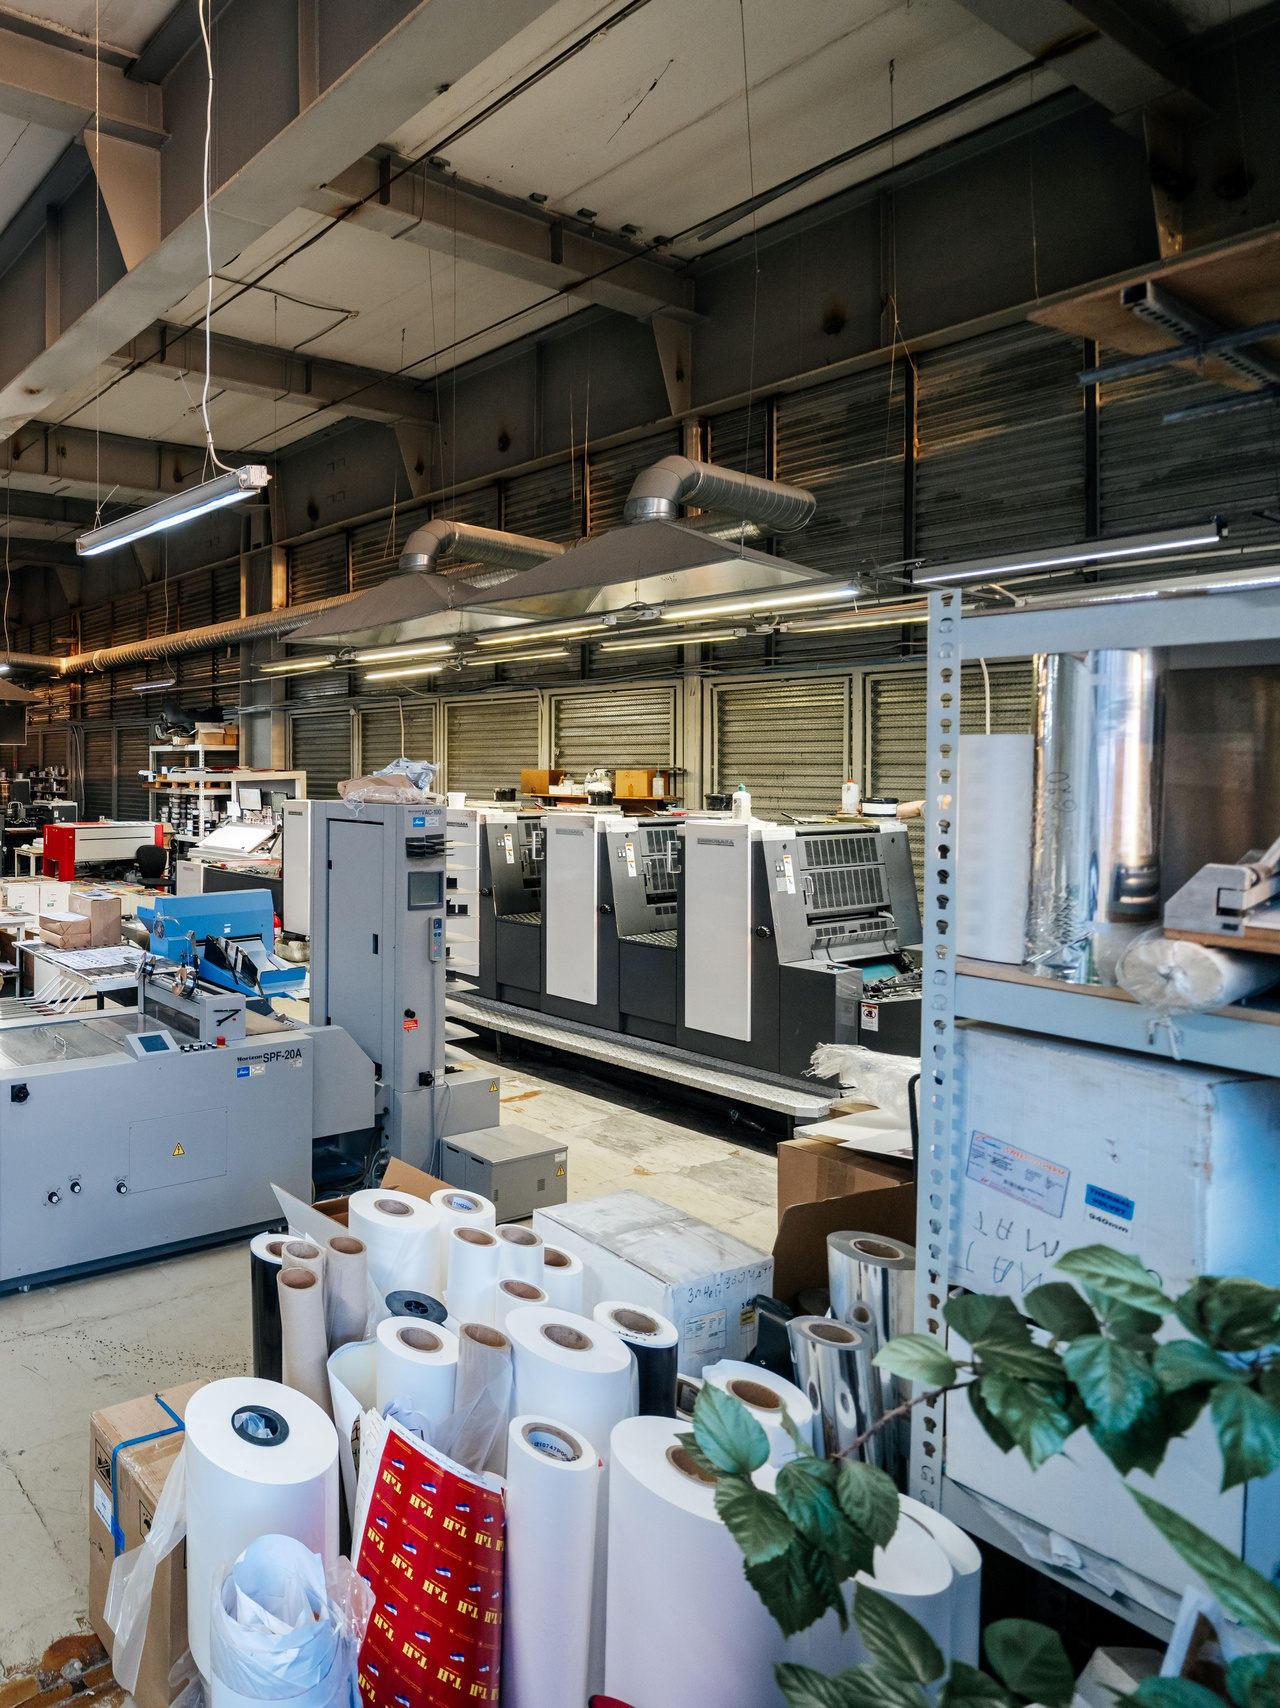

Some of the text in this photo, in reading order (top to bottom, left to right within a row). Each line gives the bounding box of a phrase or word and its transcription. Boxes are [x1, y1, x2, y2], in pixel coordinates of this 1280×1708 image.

[421, 808, 442, 816] VAC-100
[237, 1048, 302, 1063] Horizon SPF-20A
[1089, 1187, 1131, 1208] THERMAL
[1092, 1198, 1127, 1215] VELVET
[1089, 1213, 1129, 1234] 940mm
[382, 1469, 402, 1495] T&H
[409, 1493, 434, 1519] T&H
[442, 1516, 467, 1539] T&H
[391, 1552, 414, 1580] T&H
[422, 1579, 448, 1605] T&H
[457, 1600, 479, 1619] T&H
[373, 1613, 394, 1642] T&H
[402, 1642, 427, 1670] T&H
[358, 1673, 376, 1703] T&H
[437, 1667, 462, 1690] T&H
